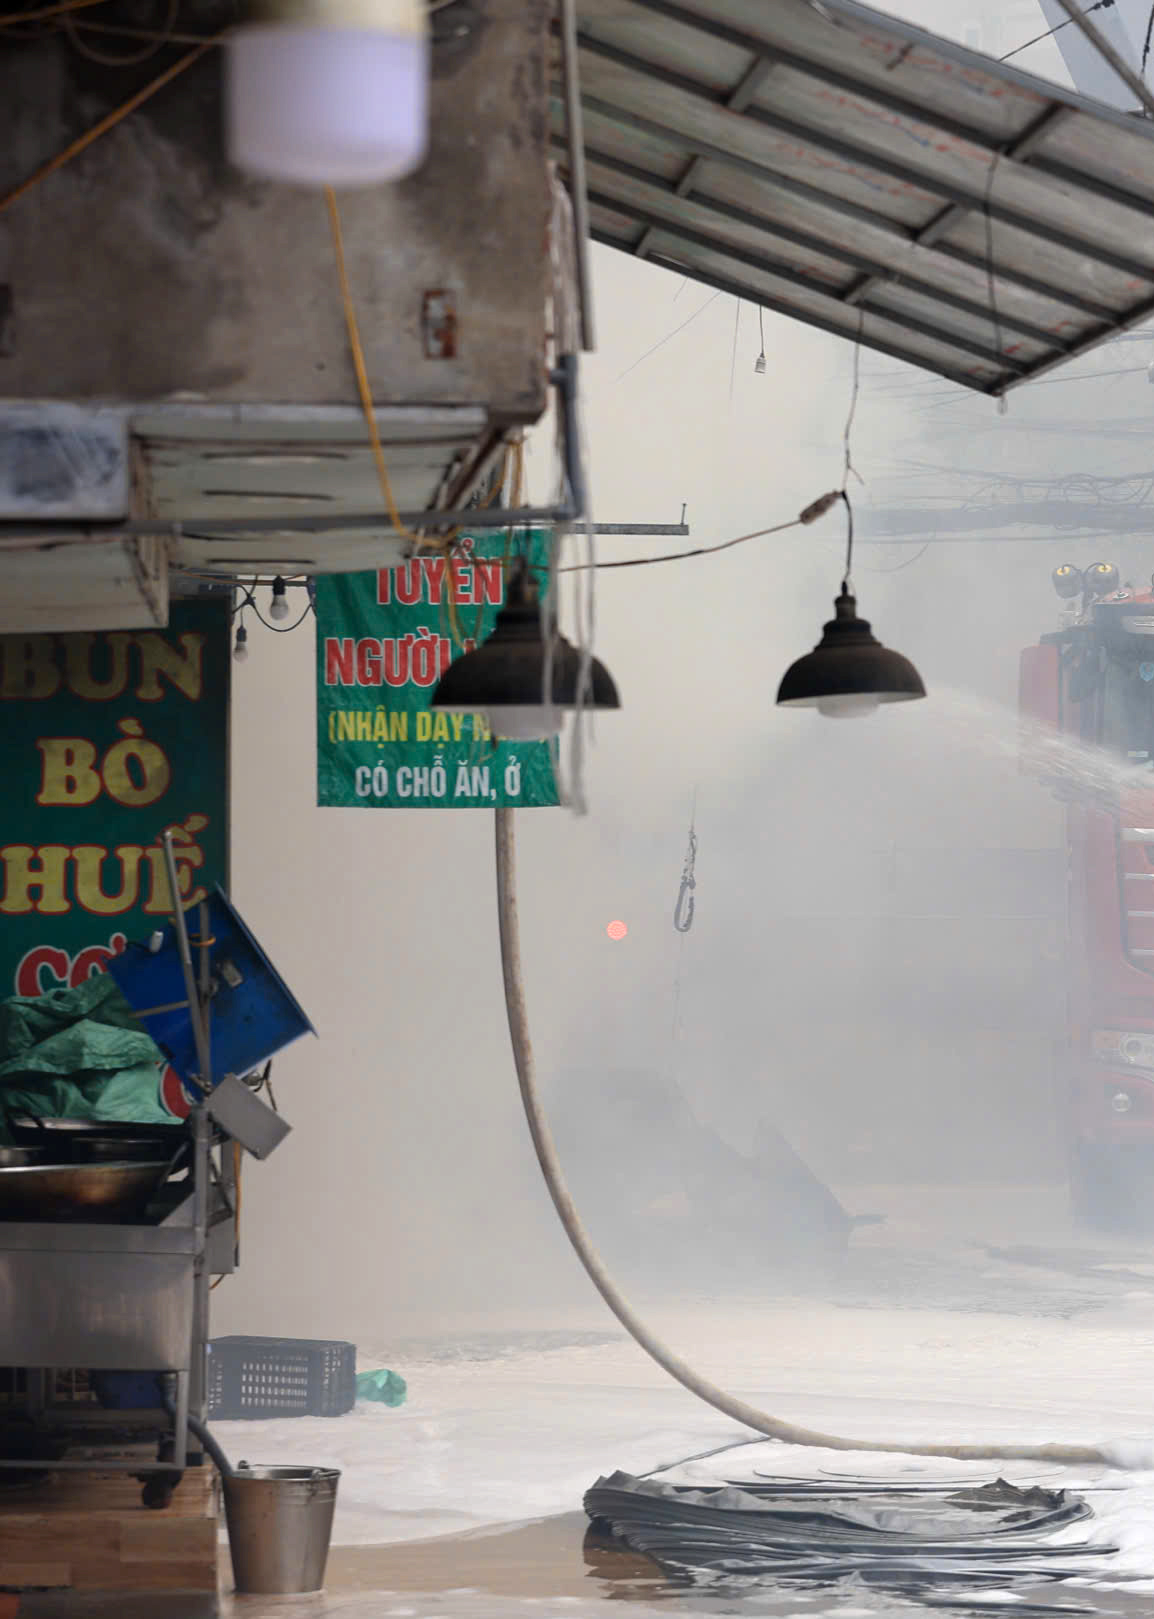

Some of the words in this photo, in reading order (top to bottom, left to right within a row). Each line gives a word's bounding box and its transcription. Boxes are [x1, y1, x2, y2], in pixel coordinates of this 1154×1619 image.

[36, 717, 170, 807] BÒ
[416, 711, 464, 749] DẠY
[354, 760, 389, 797] CÓ
[396, 755, 448, 798] CHỖ
[454, 759, 497, 801] ĂN,
[504, 755, 522, 797] Ở
[0, 813, 209, 914] HUẾ
